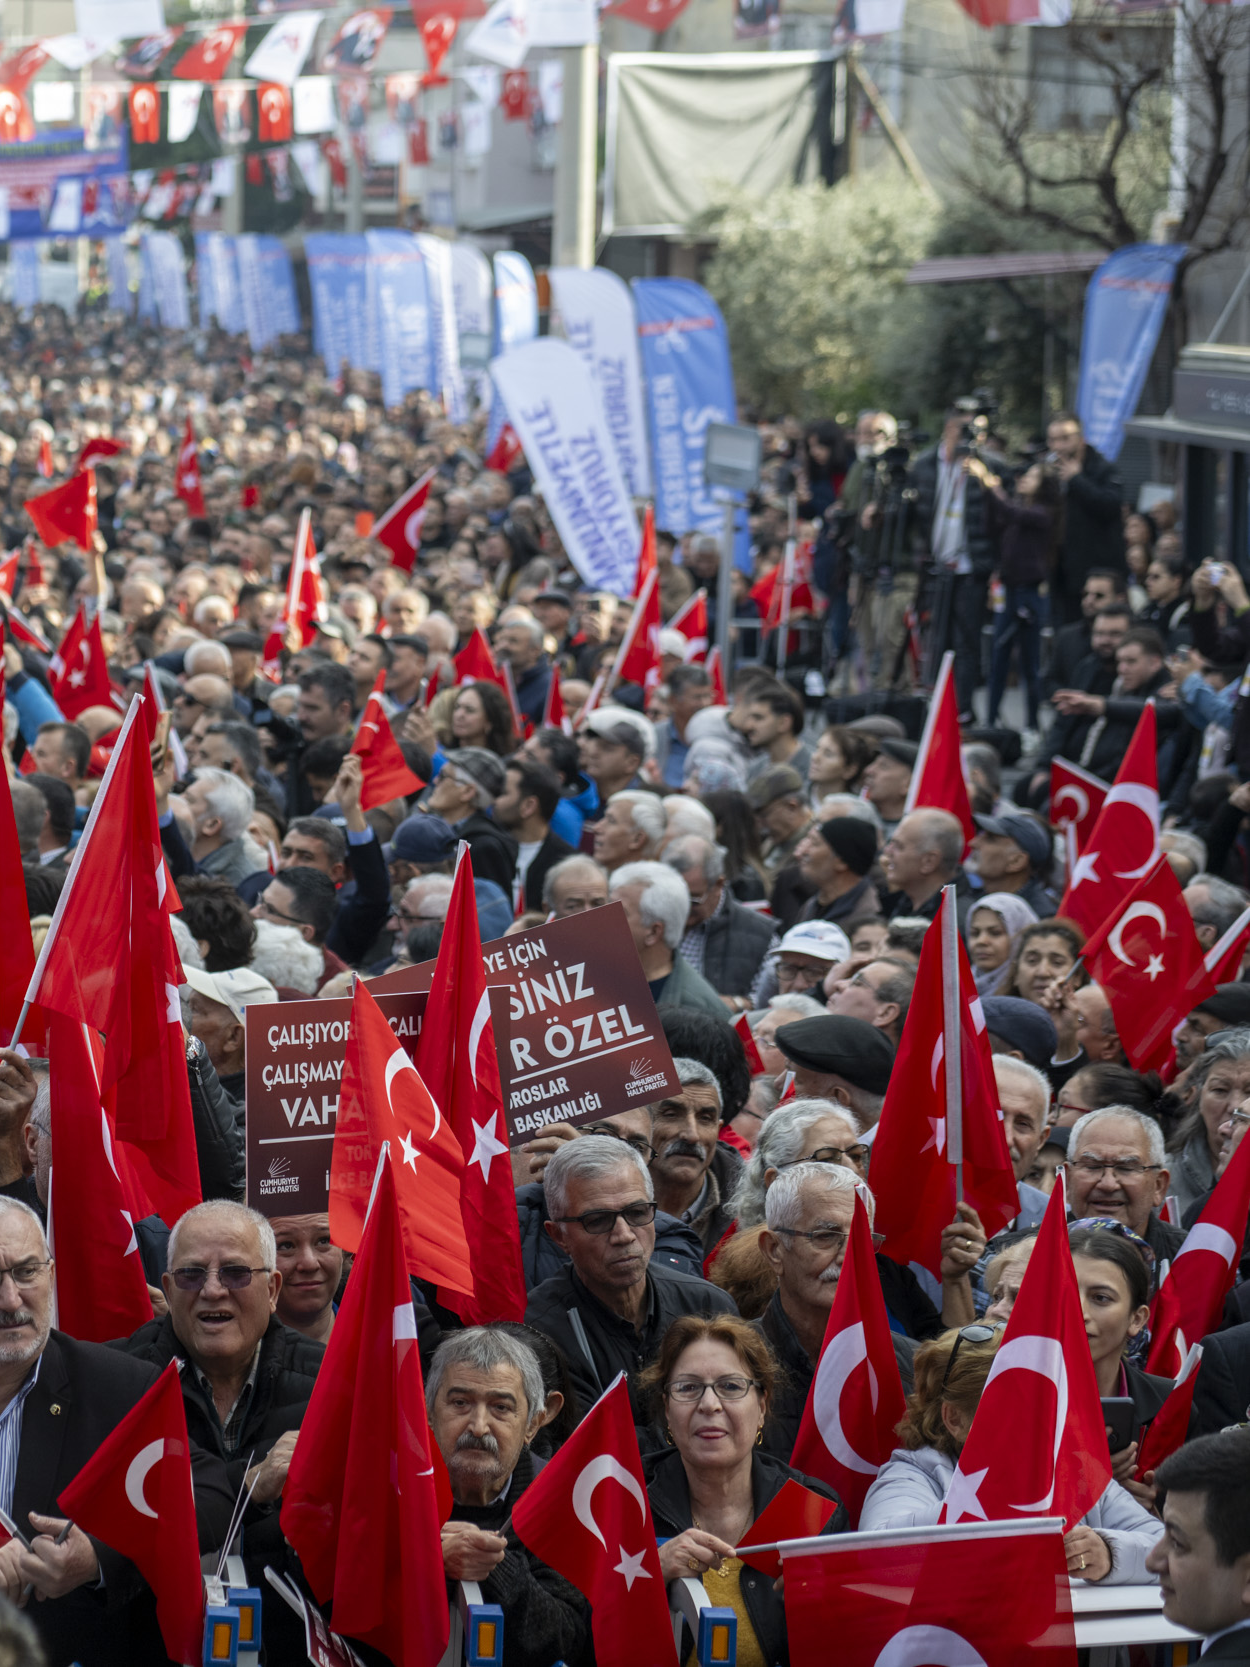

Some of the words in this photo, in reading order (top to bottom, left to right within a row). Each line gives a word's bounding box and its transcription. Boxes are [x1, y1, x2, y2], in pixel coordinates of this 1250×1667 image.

[483, 951, 508, 975] YE
[507, 938, 548, 968] İÇİN
[510, 960, 595, 1021] SİNİZ
[268, 1021, 353, 1052] ÇALIŞIYOR
[510, 1038, 539, 1071] R
[544, 1004, 645, 1058] ÖZEL
[510, 1077, 570, 1110] ROSLAR
[625, 1072, 665, 1091] CUMHURİYET
[627, 1085, 645, 1097] HALK
[645, 1079, 668, 1093] PARTİSİ
[514, 1092, 602, 1134] BAŞKANLIĞI
[260, 1176, 299, 1188] CUMHURİYET
[260, 1186, 277, 1195] HALK
[277, 1183, 299, 1193] PARTİSİ
